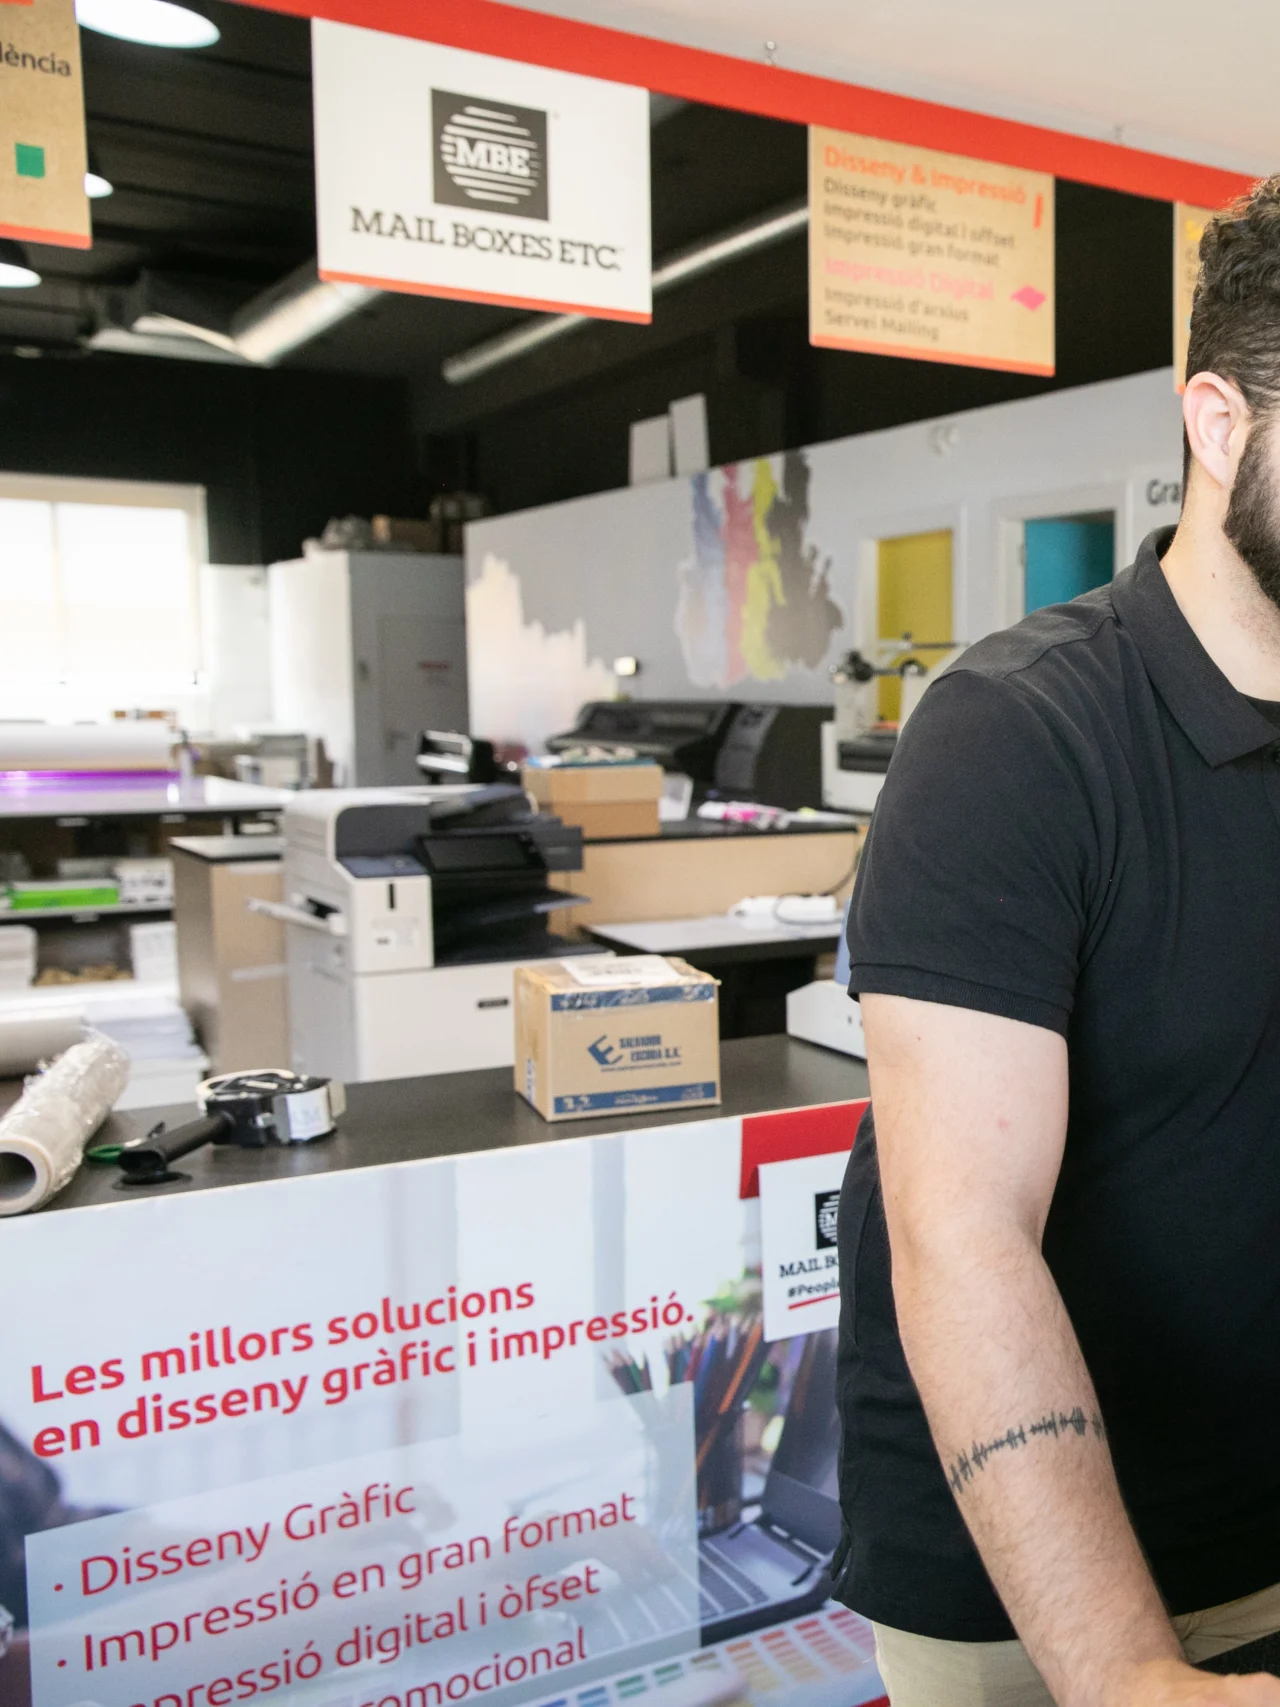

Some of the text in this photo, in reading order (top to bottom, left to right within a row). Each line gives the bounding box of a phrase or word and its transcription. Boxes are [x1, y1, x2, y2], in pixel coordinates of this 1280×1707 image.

[0, 41, 72, 77] ència
[455, 136, 531, 177] MBE
[823, 144, 1028, 205] Disseny & Impressió
[823, 176, 887, 206] Disseny
[350, 206, 445, 245] MAIL
[452, 222, 553, 261] BOXES
[823, 202, 904, 229] Impressió
[908, 213, 959, 239] digital
[823, 223, 999, 267] Impressió gran format
[824, 255, 995, 301] Impressió Digital
[823, 308, 940, 341] Servei Mailing
[779, 1257, 823, 1279] MAIL
[31, 1282, 535, 1404] Les millors solucions
[33, 1291, 694, 1458] en disseny gràfic i impressió.
[81, 1482, 416, 1597] Disseny Gràfic
[84, 1491, 637, 1672] Impressió en gran format
[335, 1596, 469, 1668] digital
[478, 1592, 488, 1627] i
[497, 1565, 602, 1620] òfset
